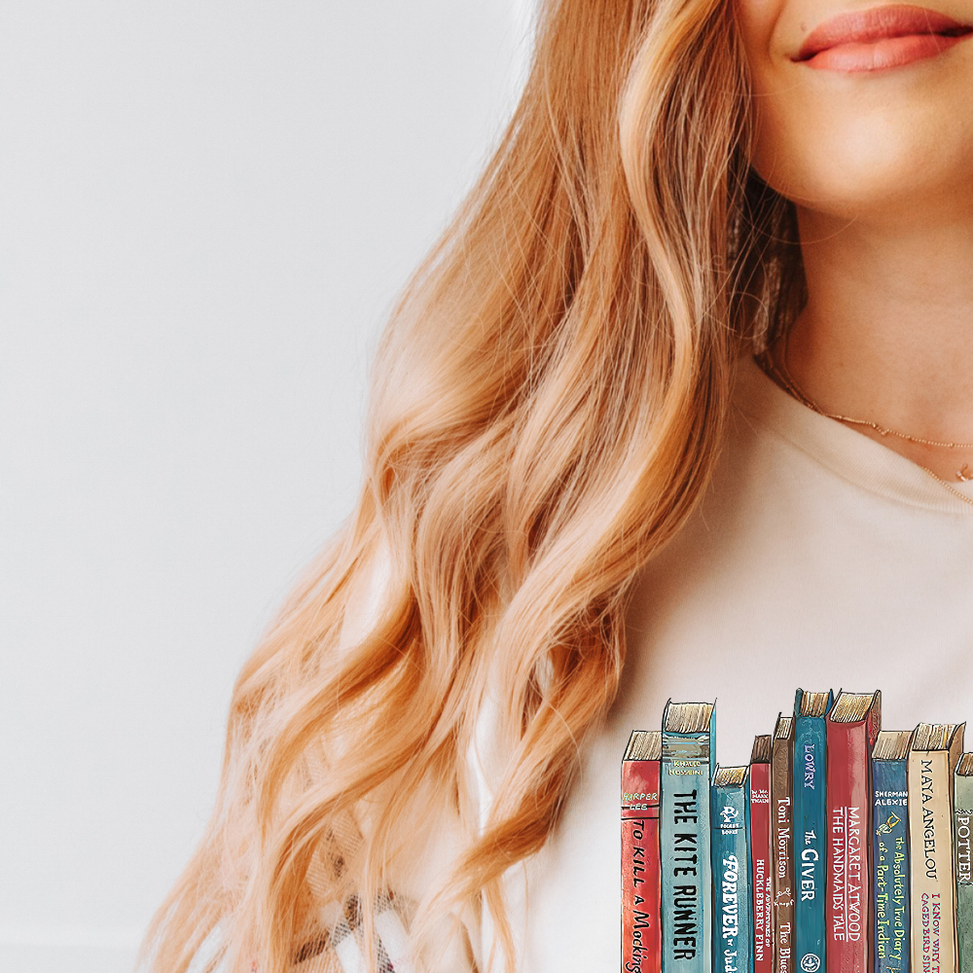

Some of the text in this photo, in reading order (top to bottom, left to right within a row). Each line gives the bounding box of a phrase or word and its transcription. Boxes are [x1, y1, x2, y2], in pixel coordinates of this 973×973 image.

[803, 744, 816, 790] LOWRY
[874, 798, 908, 806] ALEXIE
[920, 760, 938, 880] MAYA ANGELOU
[632, 820, 645, 841] TO
[777, 797, 791, 879] Toni Morrison
[878, 842, 888, 853] of
[957, 816, 971, 883] POTTER
[633, 846, 645, 888] KILL
[672, 789, 698, 960] THE KITE RUNNER
[801, 830, 819, 902] The GIVER
[832, 806, 845, 941] THE HANDMAID'S TALE
[848, 806, 861, 942] MARGARET ATWOOD
[634, 895, 645, 906] A
[722, 855, 739, 939] FOREVER
[755, 859, 765, 931] HUCKLEBERRY
[889, 836, 905, 960] The Absolutely True Diary
[921, 892, 930, 928] CAGED
[779, 922, 791, 944] The
[877, 919, 890, 959] Indian
[922, 928, 931, 953] BIRD
[931, 902, 941, 936] KNOW
[931, 938, 941, 964] WHY
